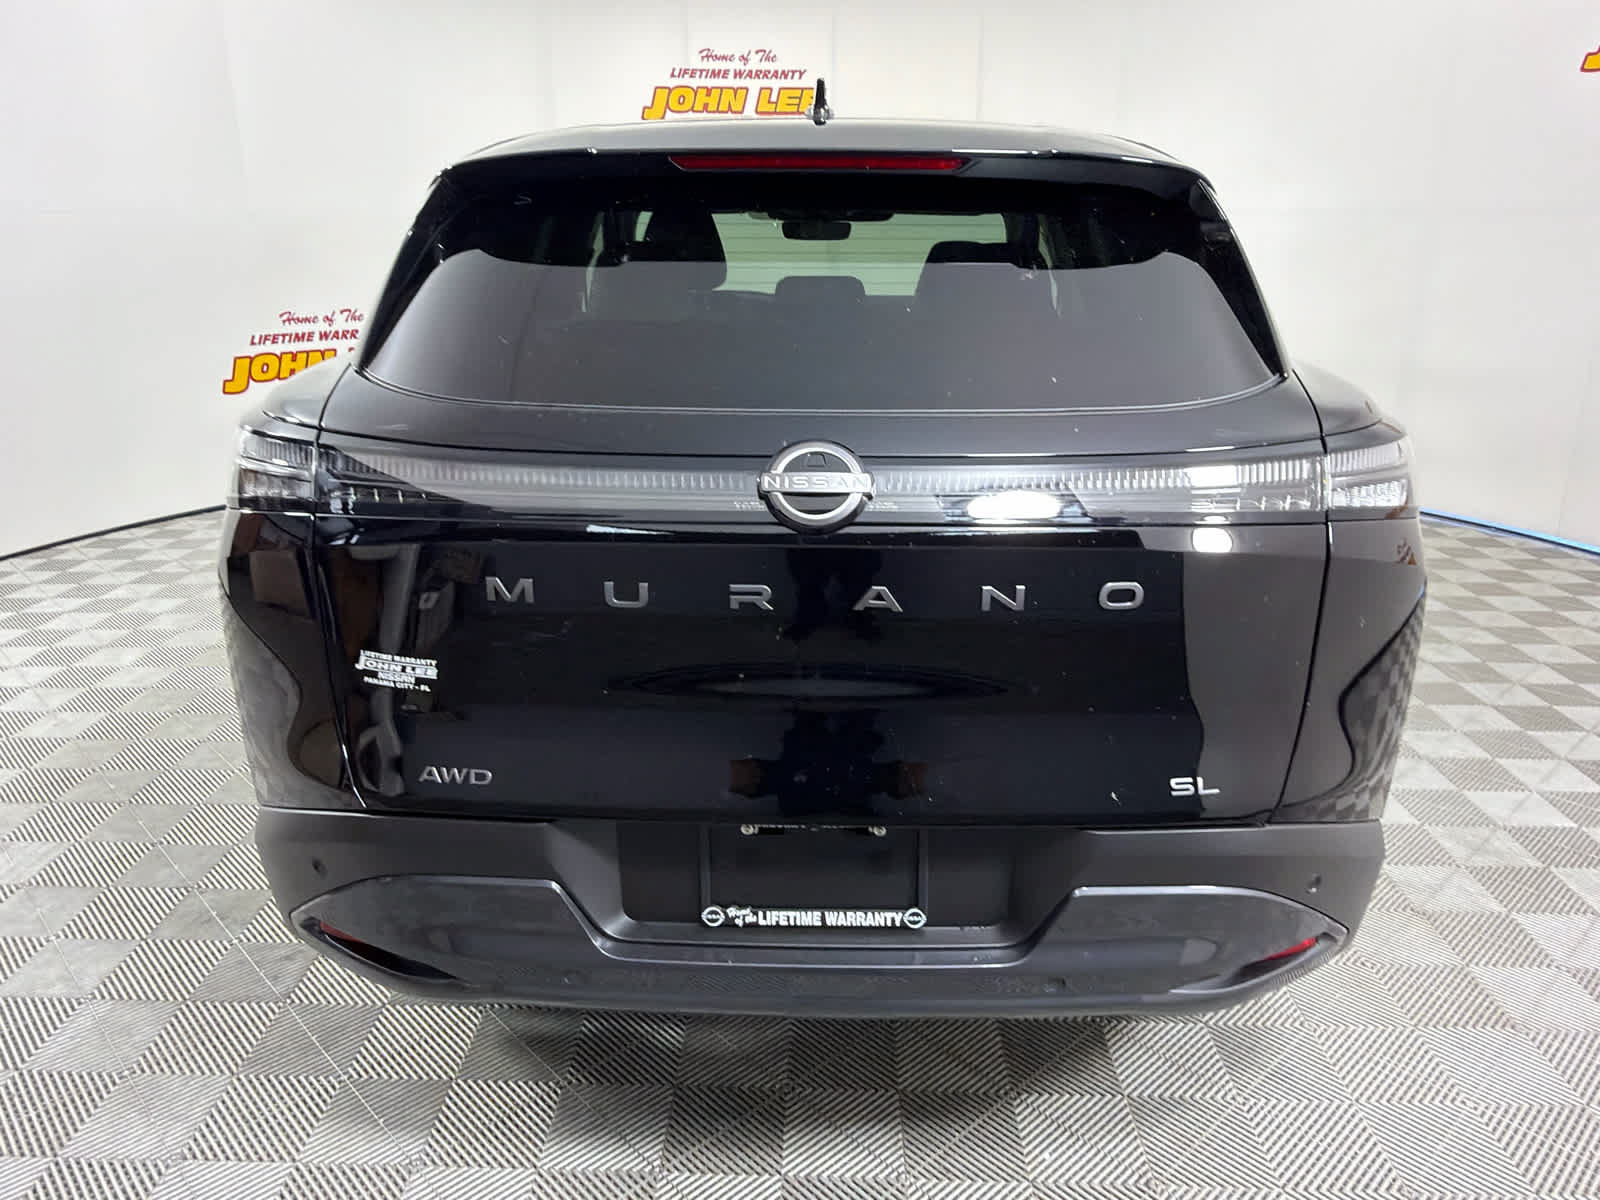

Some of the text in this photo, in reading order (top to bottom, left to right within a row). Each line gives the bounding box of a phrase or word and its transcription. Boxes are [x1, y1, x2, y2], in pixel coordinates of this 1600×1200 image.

[699, 48, 777, 66] Home of The
[670, 67, 807, 80] LIFETIME WARRANTY
[641, 85, 749, 120] JOHN
[279, 308, 364, 327] Home of The
[249, 328, 360, 346] LIFETIME WARR
[763, 475, 869, 490] NISSAN
[485, 575, 1145, 612] MURANO
[355, 656, 438, 679] JOHN LEE
[419, 766, 493, 784] AWD
[1170, 777, 1220, 796] SL
[758, 911, 903, 927] LIFETIME WARRANTY
